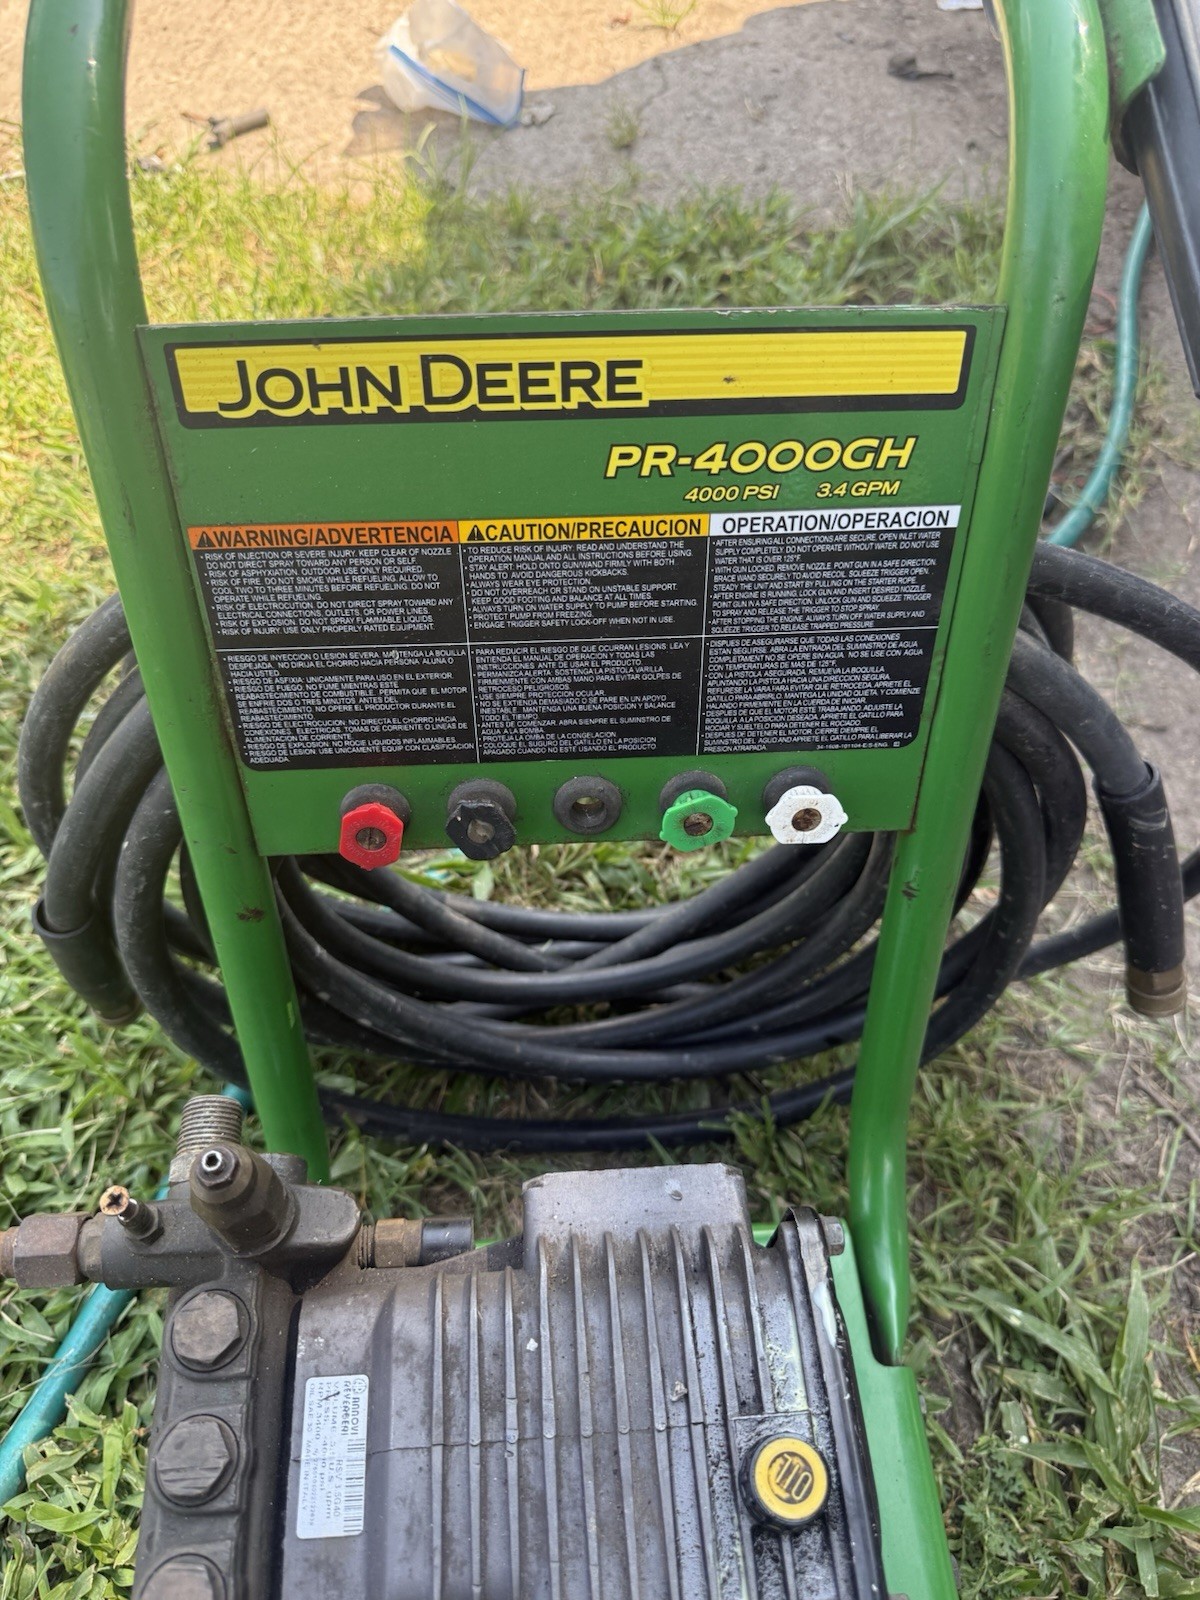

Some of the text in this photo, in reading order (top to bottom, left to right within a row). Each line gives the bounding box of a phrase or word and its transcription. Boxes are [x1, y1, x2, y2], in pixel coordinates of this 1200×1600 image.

[218, 354, 647, 416] JOHN DEERE
[604, 436, 918, 479] PR-4000GH
[684, 485, 780, 502] 4000 PSI
[816, 480, 901, 498] 3.4 GPM
[484, 519, 701, 541] CAUTION/PRECAUCION
[722, 510, 950, 534] OPERATION/OPERACION
[213, 526, 453, 547] WARNING/ADVERTENCIA
[358, 549, 379, 557] KEEP
[576, 543, 597, 551] READ
[219, 561, 237, 569] NOT
[330, 558, 347, 566] ANY
[383, 557, 395, 565] OR
[501, 579, 523, 587] WEAR
[532, 611, 553, 619] FROM
